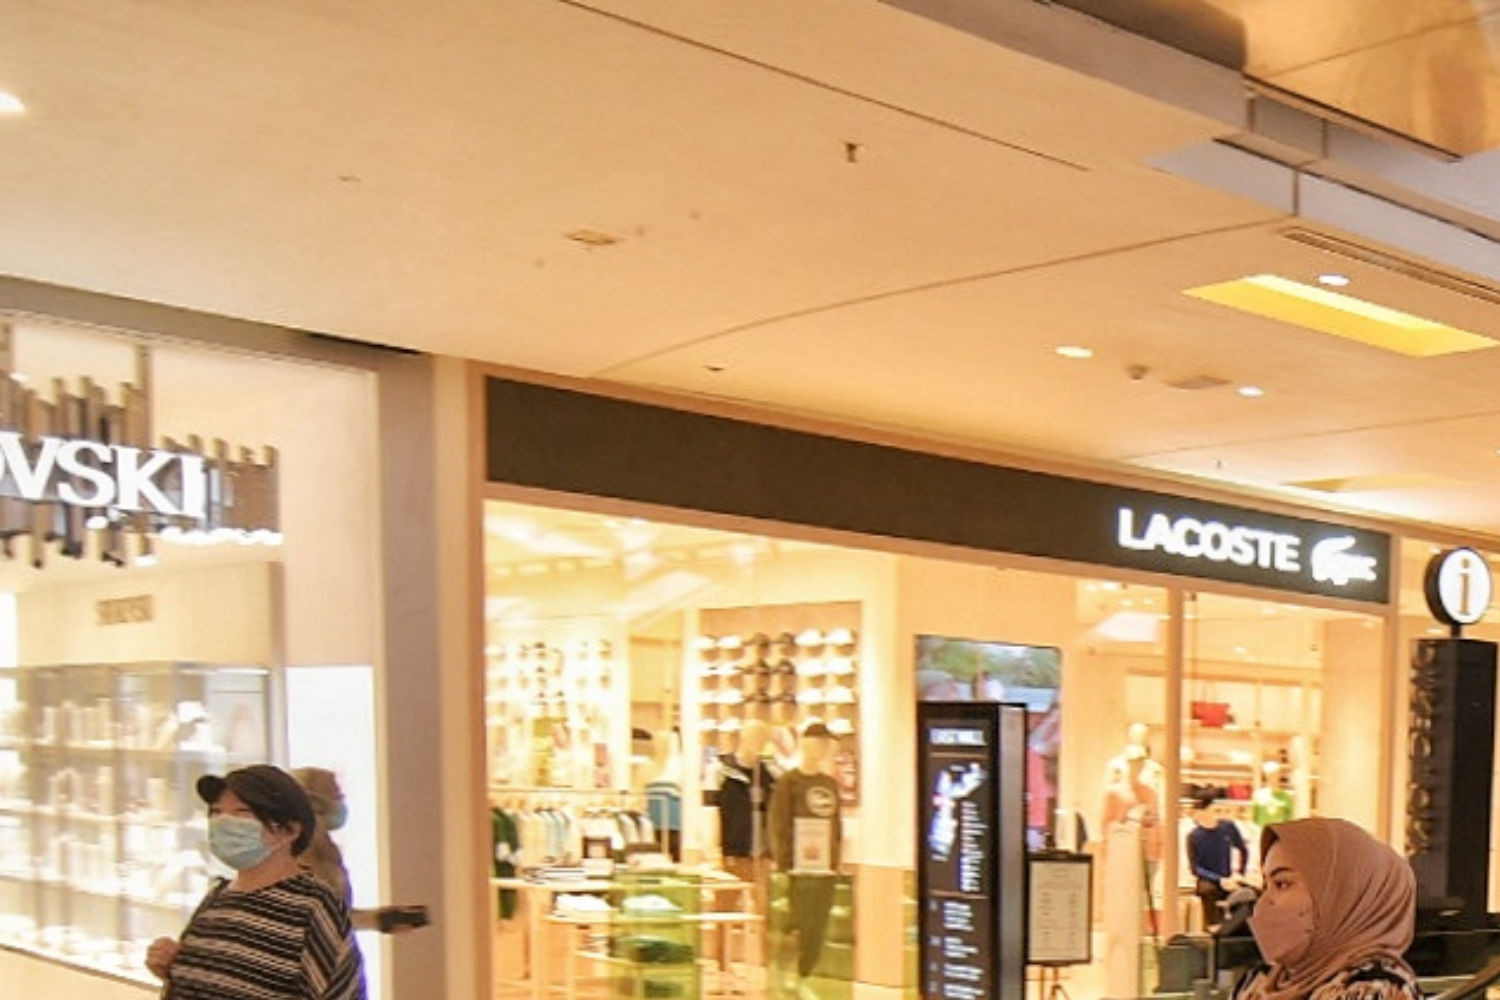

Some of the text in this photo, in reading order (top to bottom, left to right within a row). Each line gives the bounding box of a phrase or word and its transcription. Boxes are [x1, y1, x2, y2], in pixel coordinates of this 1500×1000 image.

[0, 431, 207, 518] VSKI
[1117, 508, 1300, 572] LACOSTE
[1457, 557, 1472, 616] i
